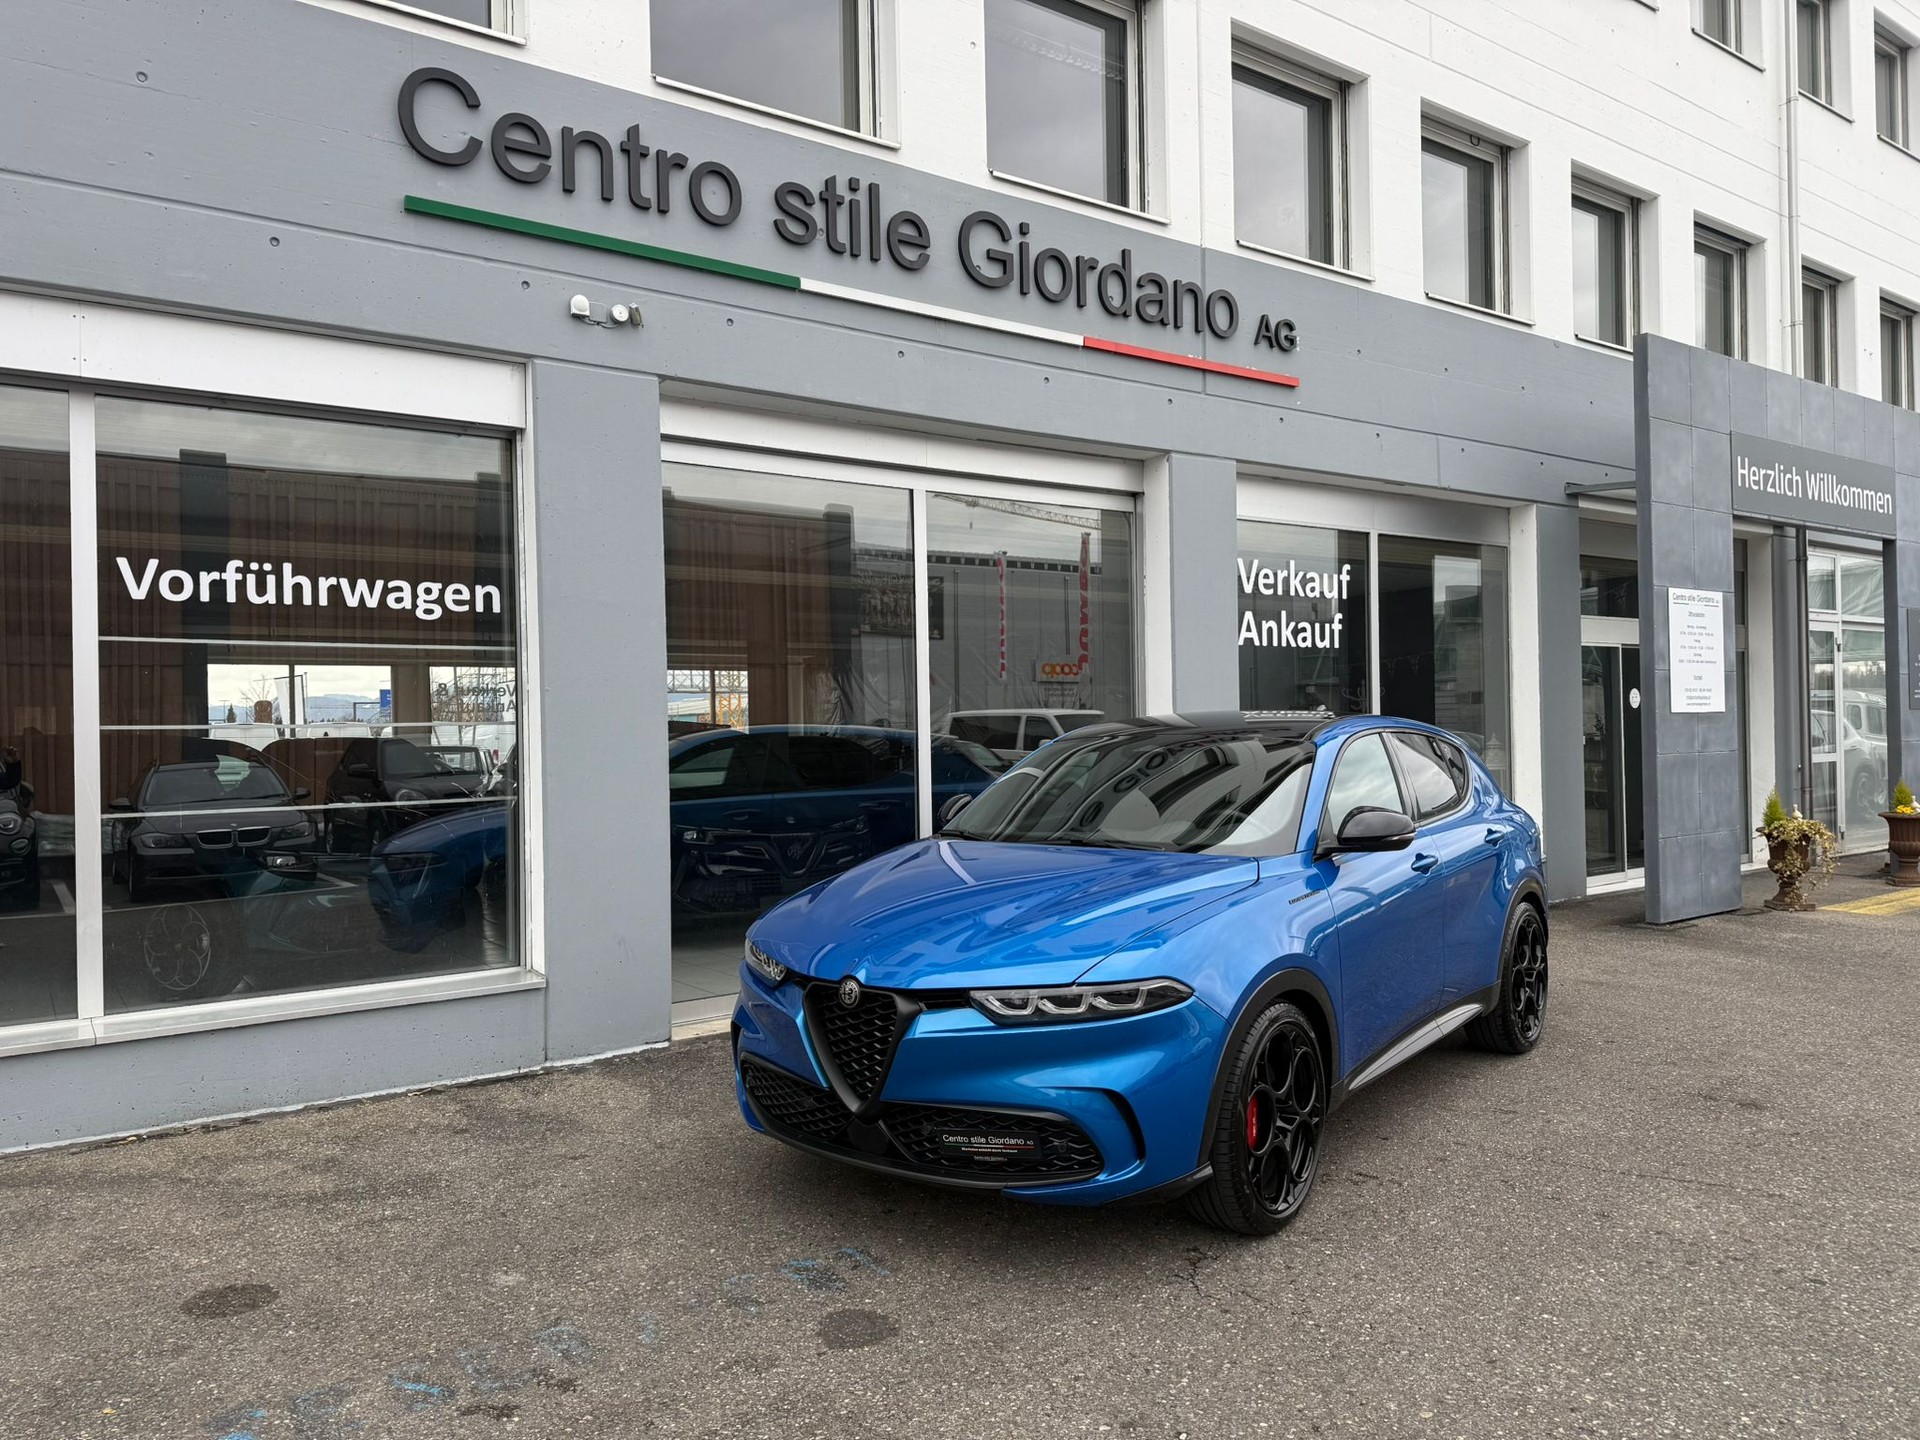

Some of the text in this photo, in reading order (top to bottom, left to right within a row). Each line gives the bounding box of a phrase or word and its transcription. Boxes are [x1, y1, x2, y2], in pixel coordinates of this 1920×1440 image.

[398, 67, 1298, 351] Centro stile Giordano AG
[1737, 455, 1893, 515] Herzlich Willkommen
[116, 556, 501, 621] Vorführwagen
[1236, 557, 1351, 600] Verkauf
[1237, 610, 1344, 649] Ankauf
[942, 1134, 969, 1143] Centro
[970, 1135, 986, 1144] stile
[987, 1136, 1025, 1145] Giordano
